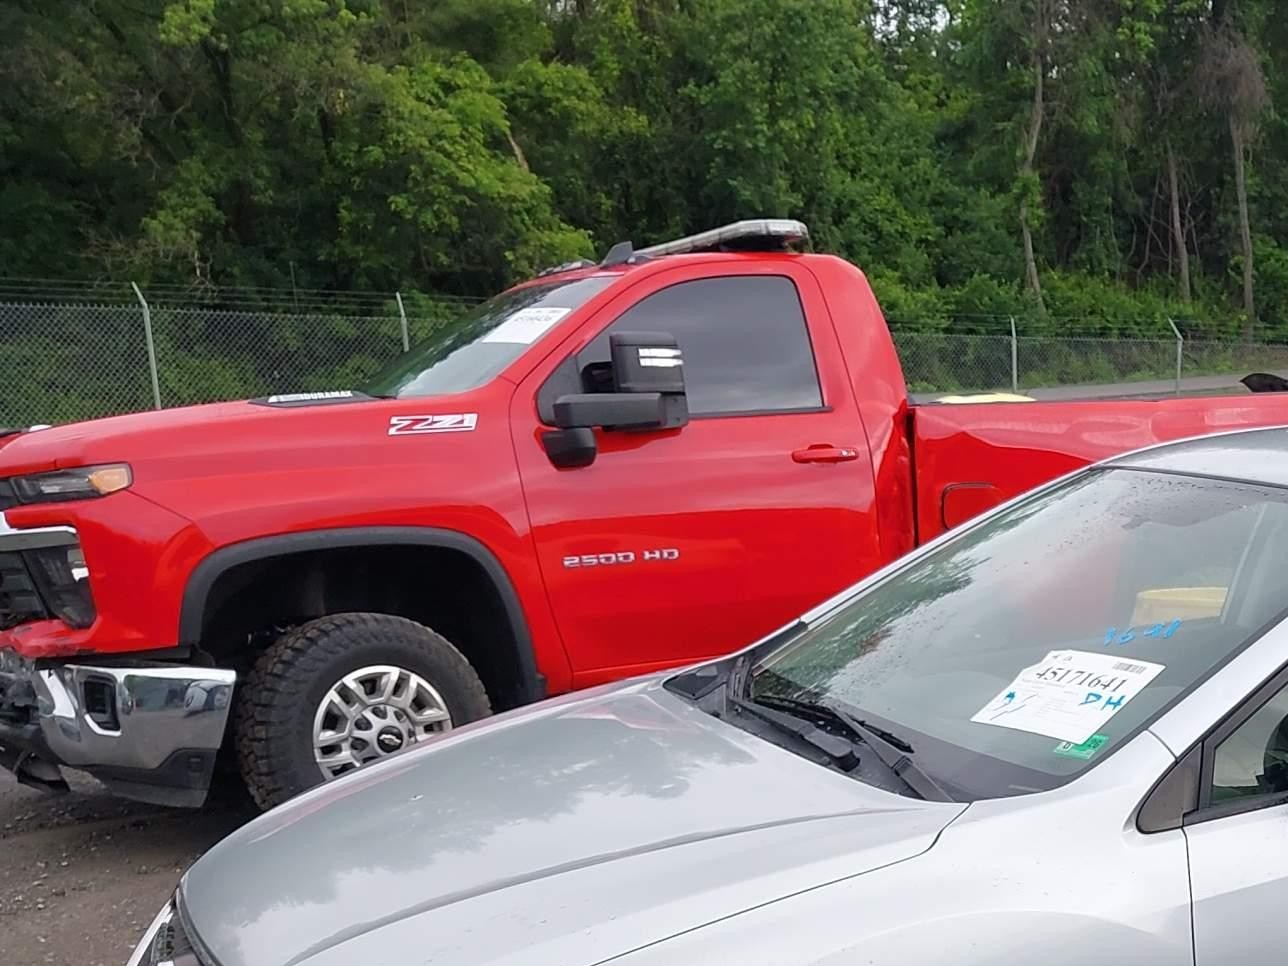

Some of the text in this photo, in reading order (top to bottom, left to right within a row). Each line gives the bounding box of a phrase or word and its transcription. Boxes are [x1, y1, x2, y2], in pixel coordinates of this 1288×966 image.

[563, 548, 679, 567] 2500 HD
[1036, 666, 1128, 692] 45171641
